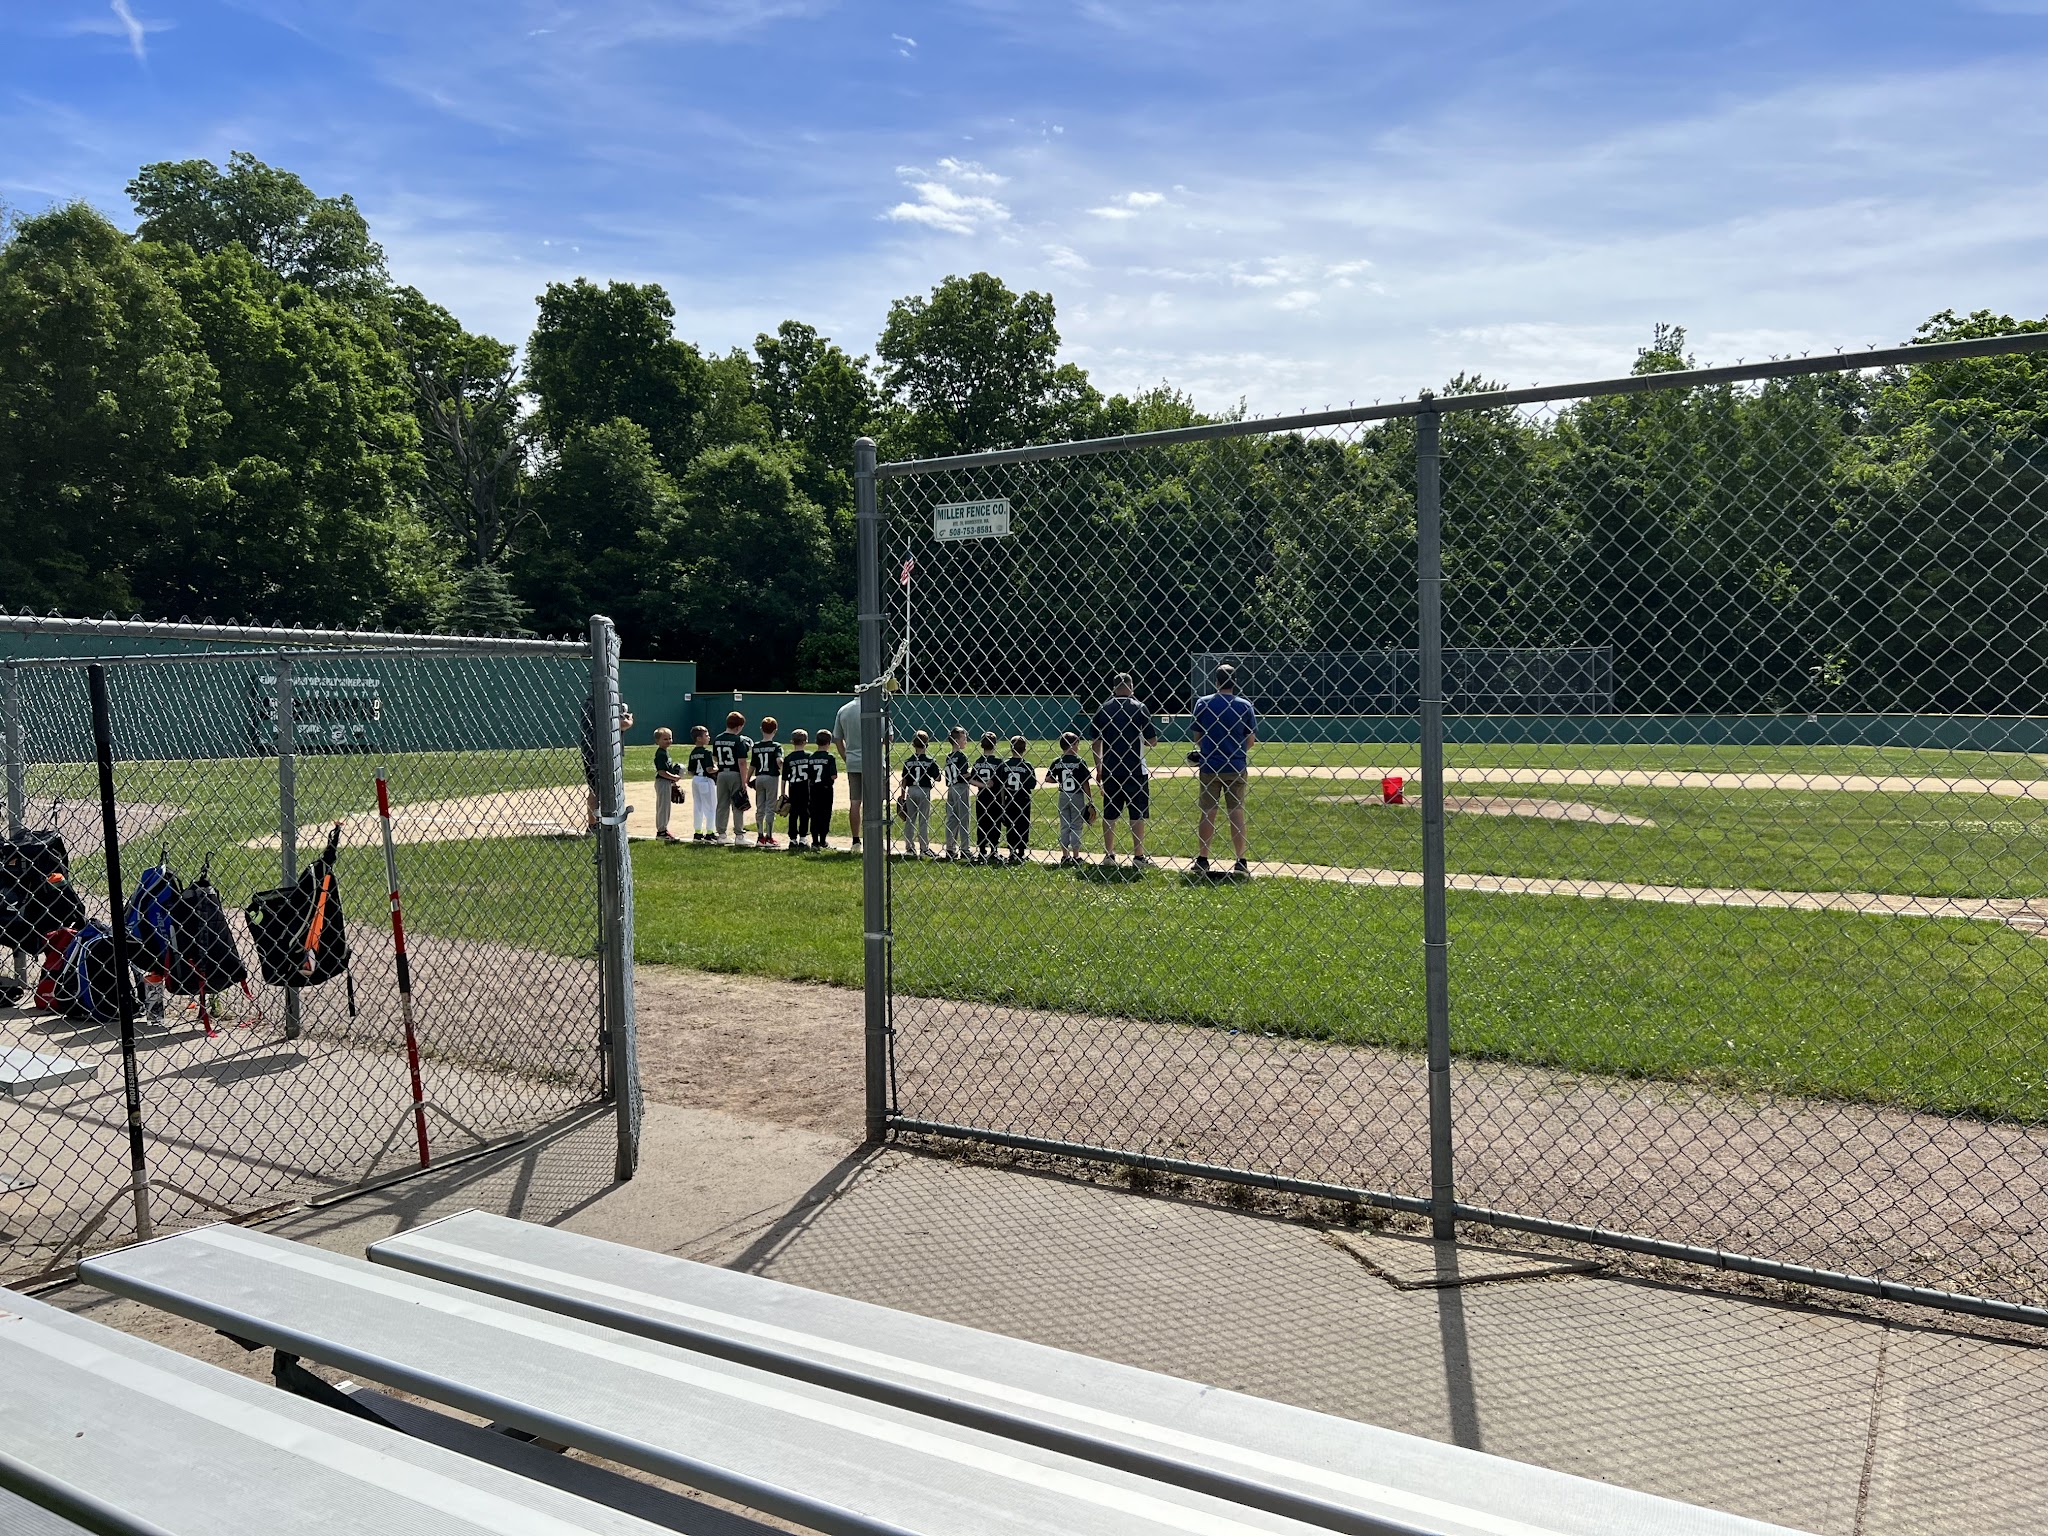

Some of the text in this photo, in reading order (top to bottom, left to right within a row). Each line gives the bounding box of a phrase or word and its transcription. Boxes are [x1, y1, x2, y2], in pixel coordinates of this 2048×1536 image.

[937, 503, 1006, 520] MILLER FENCE CO.
[716, 746, 736, 766] 13
[696, 759, 704, 777] 4
[789, 764, 809, 783] 15
[813, 764, 824, 783] 7
[913, 766, 921, 786] 1
[1007, 772, 1021, 791] 9
[1061, 769, 1076, 792] 6
